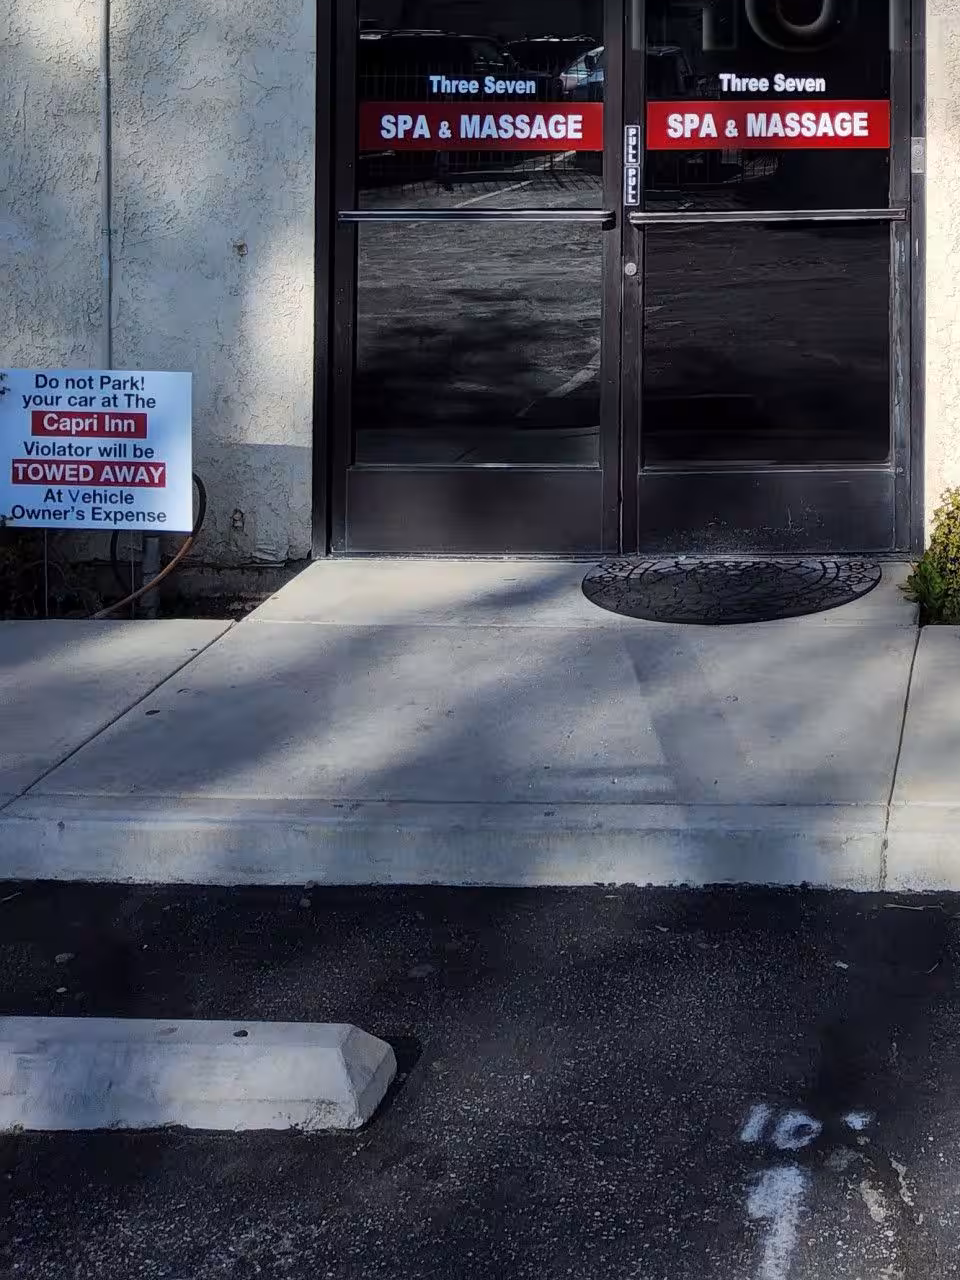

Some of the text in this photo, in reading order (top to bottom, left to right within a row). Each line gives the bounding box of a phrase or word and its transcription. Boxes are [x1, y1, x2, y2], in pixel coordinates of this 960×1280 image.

[430, 75, 536, 94] Three Seven
[720, 73, 826, 92] Three Seven
[381, 114, 583, 140] SPA & MASSAGE
[668, 112, 869, 138] SPA & MASSAGE
[628, 128, 637, 163] PULL
[628, 168, 637, 203] PULL
[35, 374, 145, 391] Do not Park!
[22, 394, 156, 409] your car at The
[43, 413, 135, 434] Capri Inn
[24, 441, 154, 459] Violator will be
[14, 463, 164, 484] TOWED AWAY
[43, 489, 135, 505] At Vehicle
[11, 505, 167, 524] Owner's Expense
